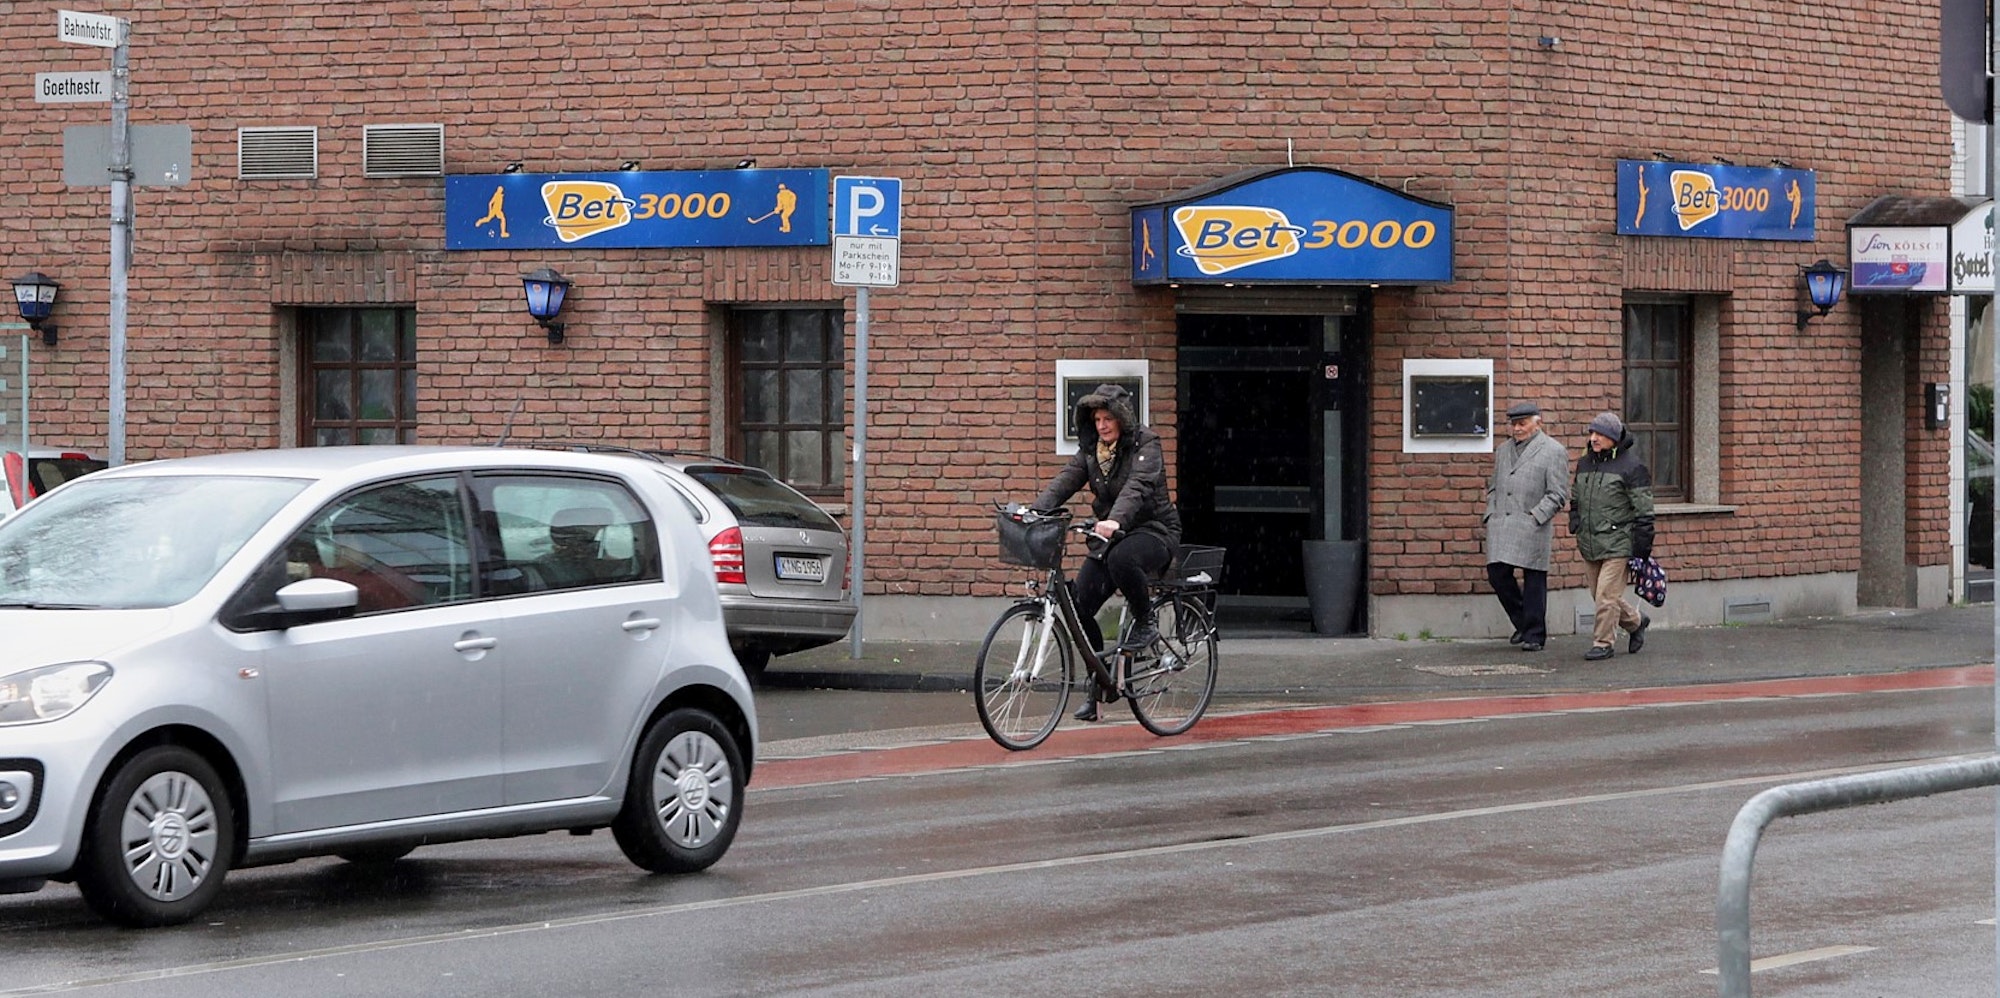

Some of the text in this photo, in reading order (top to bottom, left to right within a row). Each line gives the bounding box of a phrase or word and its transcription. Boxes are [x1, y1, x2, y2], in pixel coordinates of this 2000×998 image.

[64, 17, 114, 41] Bahnhofstr.
[43, 78, 103, 96] Goethestr.
[557, 192, 731, 221] Bet 3000
[1678, 182, 1769, 212] Bet 3000
[849, 186, 885, 235] P
[1195, 219, 1436, 249] Bet 3000
[839, 261, 865, 270] Mo-Fr
[842, 251, 890, 260] Parkschein
[1954, 251, 1990, 285] Hotel
[839, 271, 850, 279] Sa
